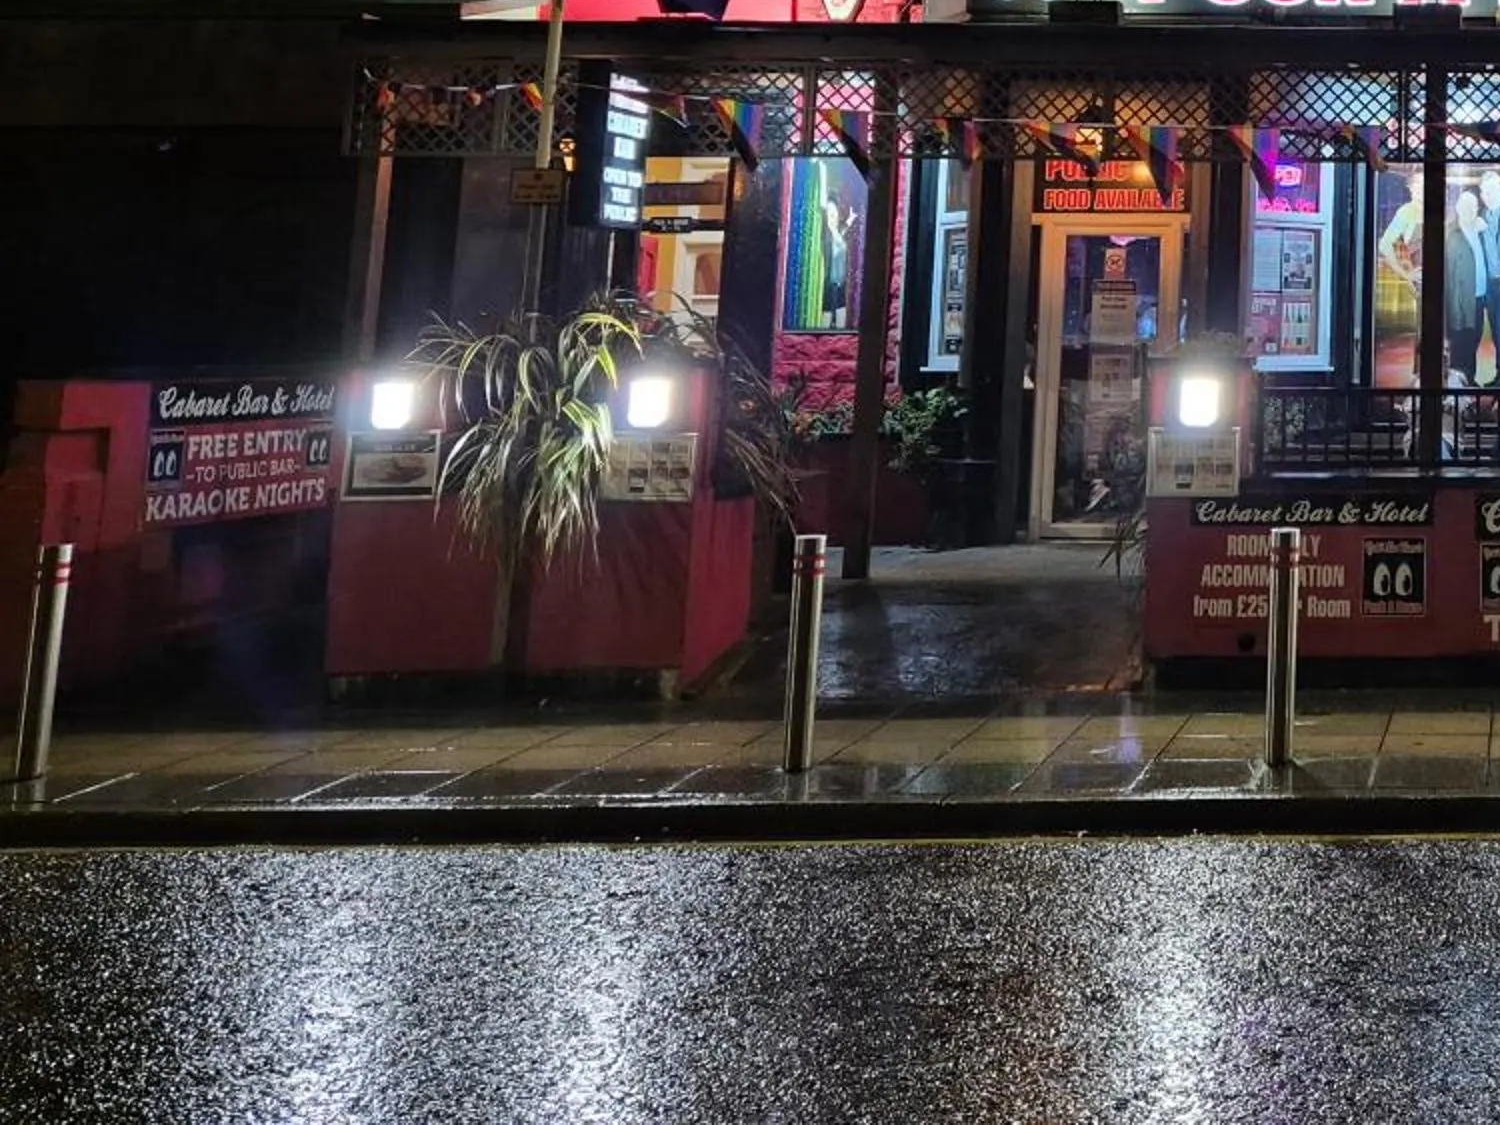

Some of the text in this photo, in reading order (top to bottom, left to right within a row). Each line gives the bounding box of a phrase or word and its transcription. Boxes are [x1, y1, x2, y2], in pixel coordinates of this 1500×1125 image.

[1044, 189, 1091, 210] FOOD
[159, 384, 335, 419] Cabaret Bar & Hotel
[188, 428, 306, 460] FREE ENTRY
[219, 460, 267, 480] PUBLIC
[145, 477, 325, 522] KARAOKE NIGHTS
[1196, 500, 1429, 523] Cabaret Bar & Hotel
[1200, 564, 1345, 588] ACCOMMATION
[1193, 595, 1232, 617] from
[1236, 595, 1268, 618] £25
[1307, 595, 1351, 618] Room
